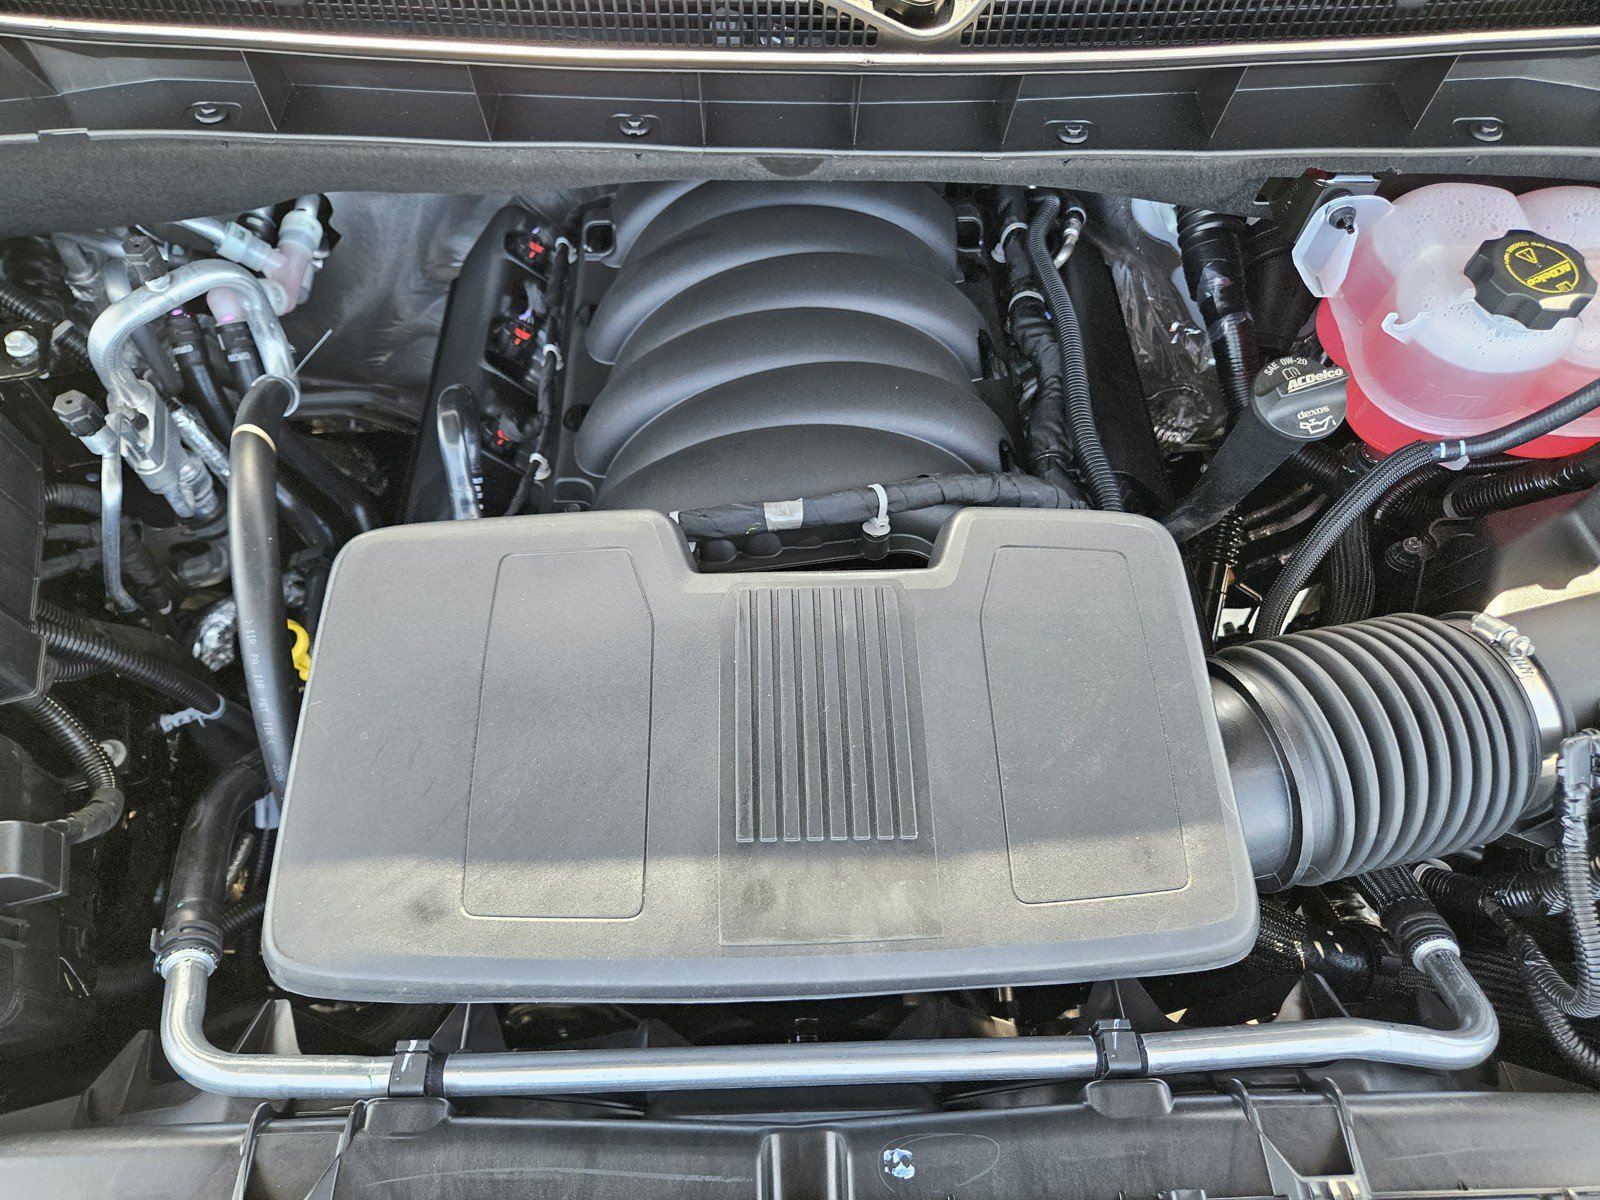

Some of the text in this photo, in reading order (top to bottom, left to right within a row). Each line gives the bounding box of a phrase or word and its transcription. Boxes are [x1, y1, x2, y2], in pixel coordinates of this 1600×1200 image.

[1526, 262, 1572, 286] ACDelco
[1263, 356, 1309, 376] SAE 0W-20
[1286, 368, 1344, 391] ACDelco
[1296, 405, 1330, 420] dexos
